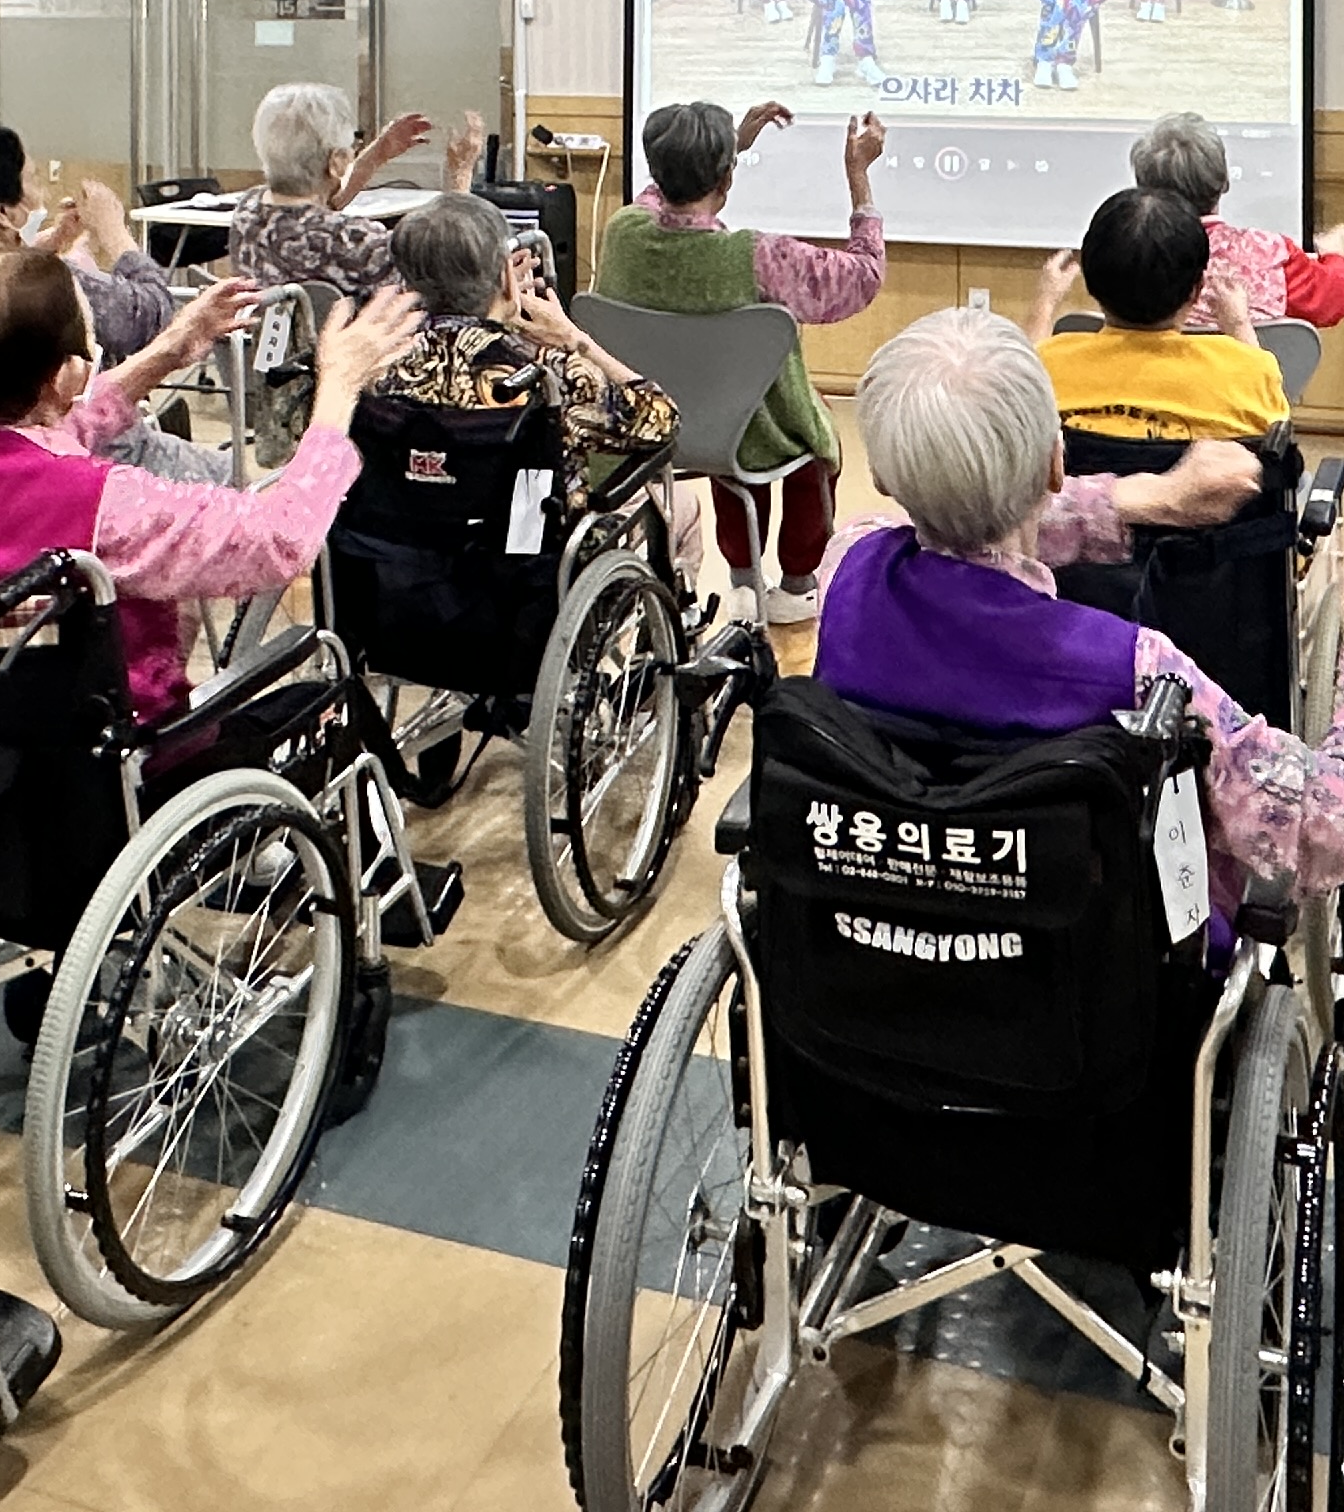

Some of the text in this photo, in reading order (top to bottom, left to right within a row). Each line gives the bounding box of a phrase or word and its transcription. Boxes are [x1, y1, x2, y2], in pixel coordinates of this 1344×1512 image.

[880, 76, 1024, 106] 으샤라 차차
[806, 800, 1027, 874] 쌍용의료기
[834, 912, 1024, 962] SSANGYONG
